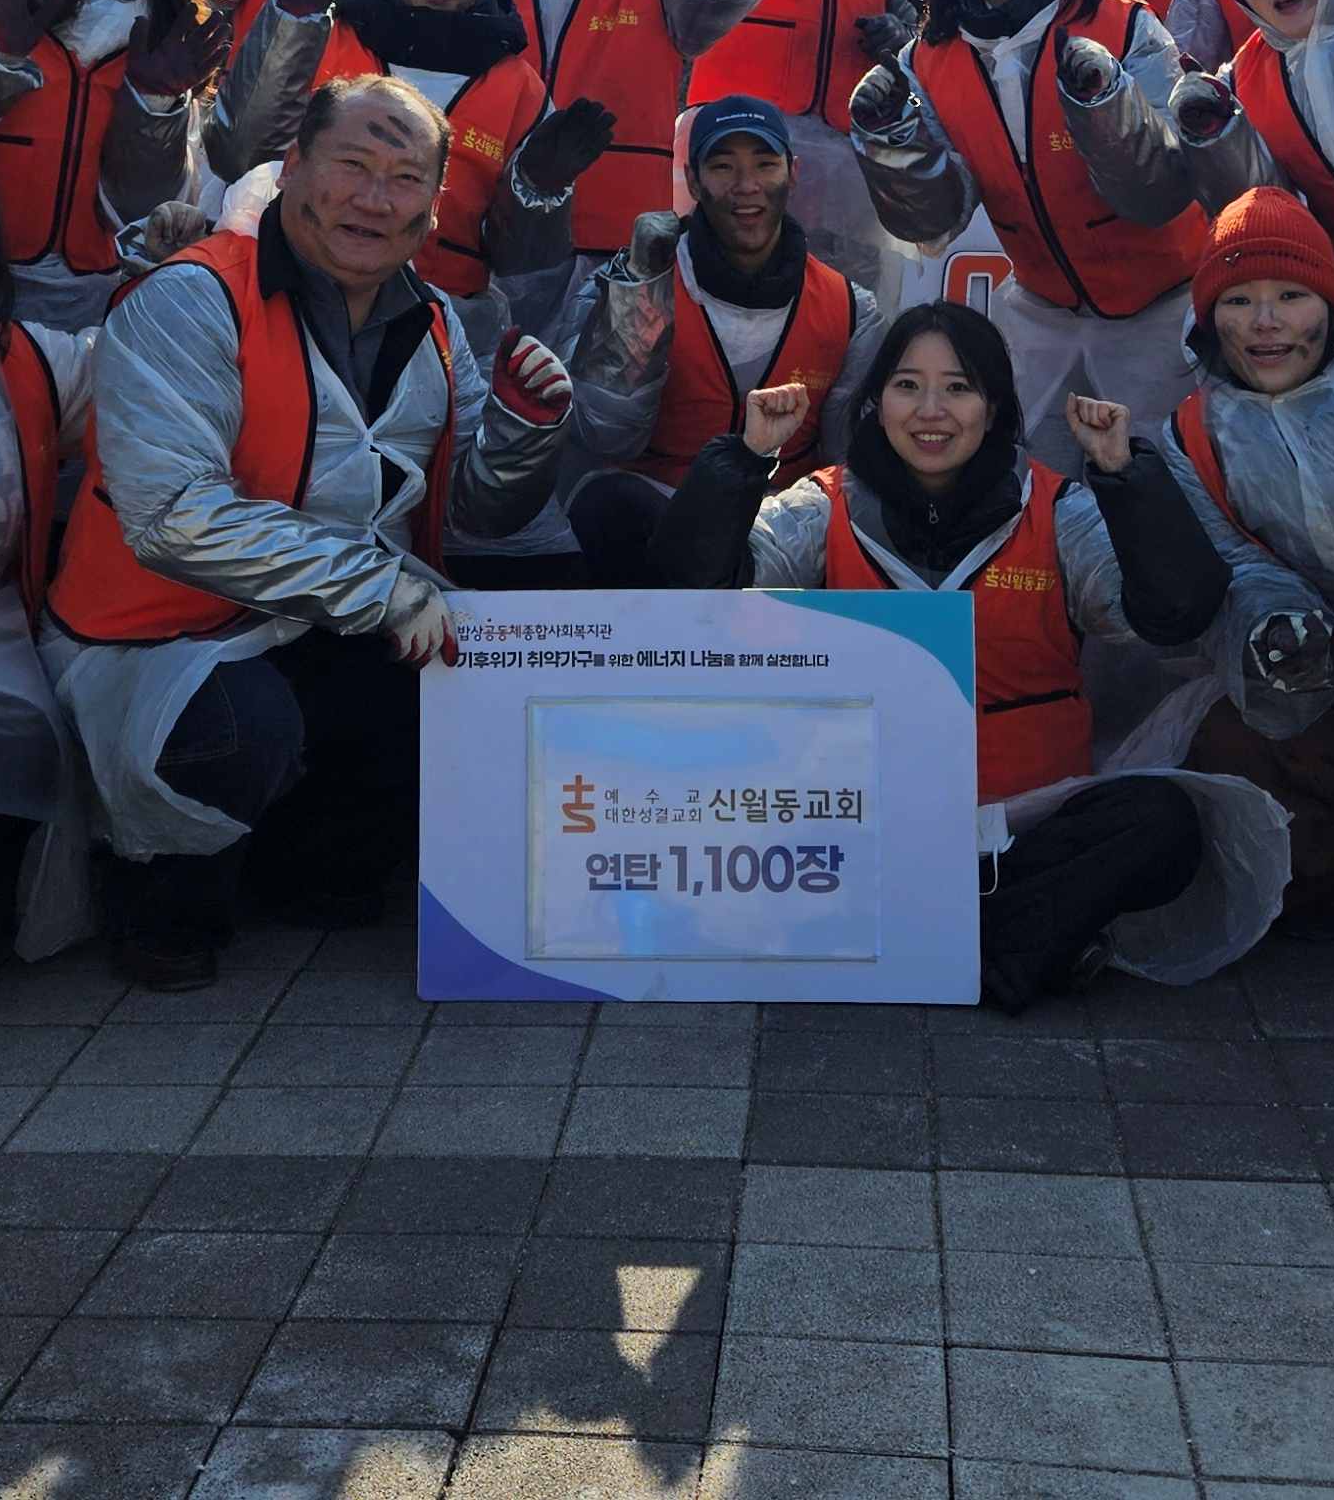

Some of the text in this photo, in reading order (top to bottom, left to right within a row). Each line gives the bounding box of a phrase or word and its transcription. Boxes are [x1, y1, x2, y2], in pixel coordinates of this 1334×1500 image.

[474, 137, 505, 163] 신월동
[457, 623, 613, 642] 밥상공동체종합사회복지관
[457, 650, 830, 669] 기후위기 취약가구를 위한 에너지 나눔을 함께 실천합니다
[604, 807, 702, 824] 대한성결교회
[708, 787, 863, 824] 신월동교회
[586, 844, 845, 896] 연탄 1,100장
